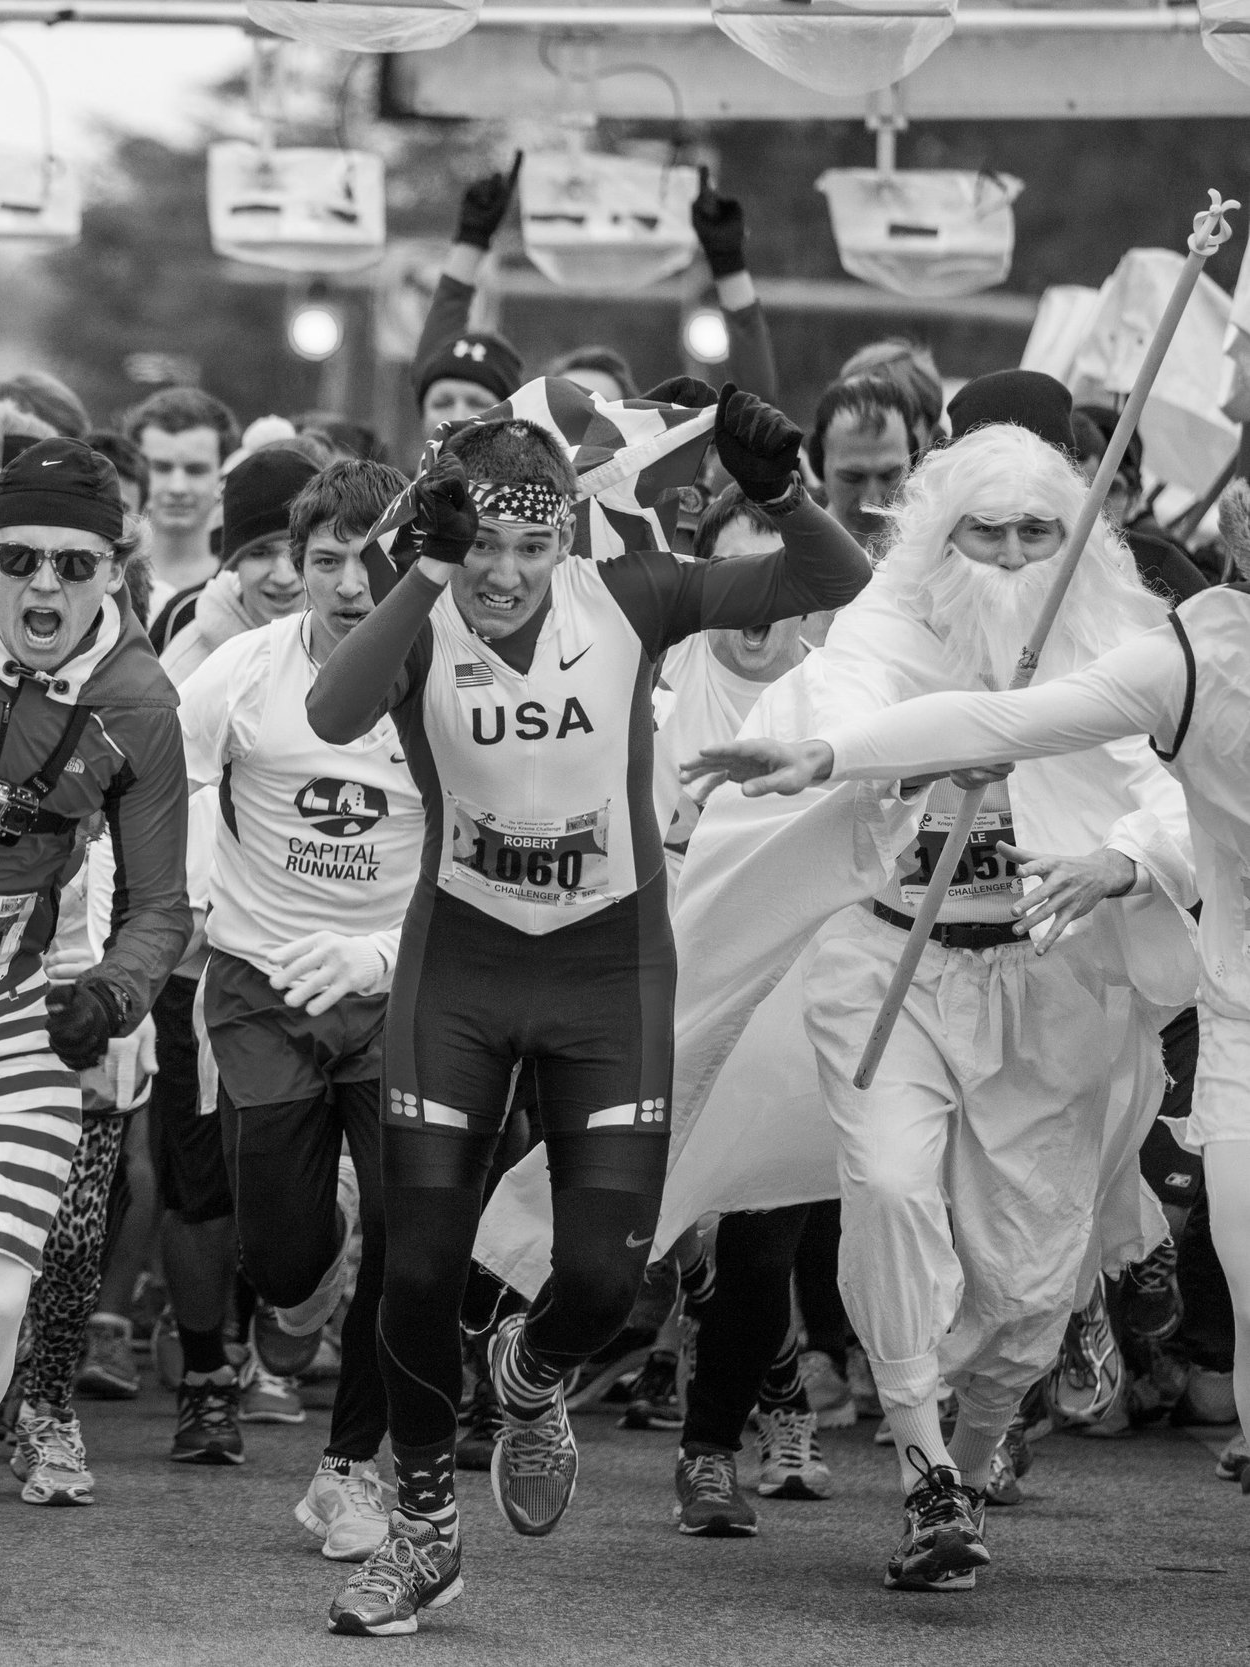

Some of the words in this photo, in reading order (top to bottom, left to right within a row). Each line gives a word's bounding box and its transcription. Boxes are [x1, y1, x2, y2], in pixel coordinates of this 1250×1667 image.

[472, 696, 594, 745] USA
[500, 823, 517, 831] Krispy
[289, 837, 381, 865] CAPITAL
[503, 835, 559, 850] ROBERT
[285, 855, 380, 881] RUNWALK
[470, 837, 583, 890] 1060
[494, 884, 561, 901] CHALLENGER
[948, 882, 1013, 897] CHALLENGER
